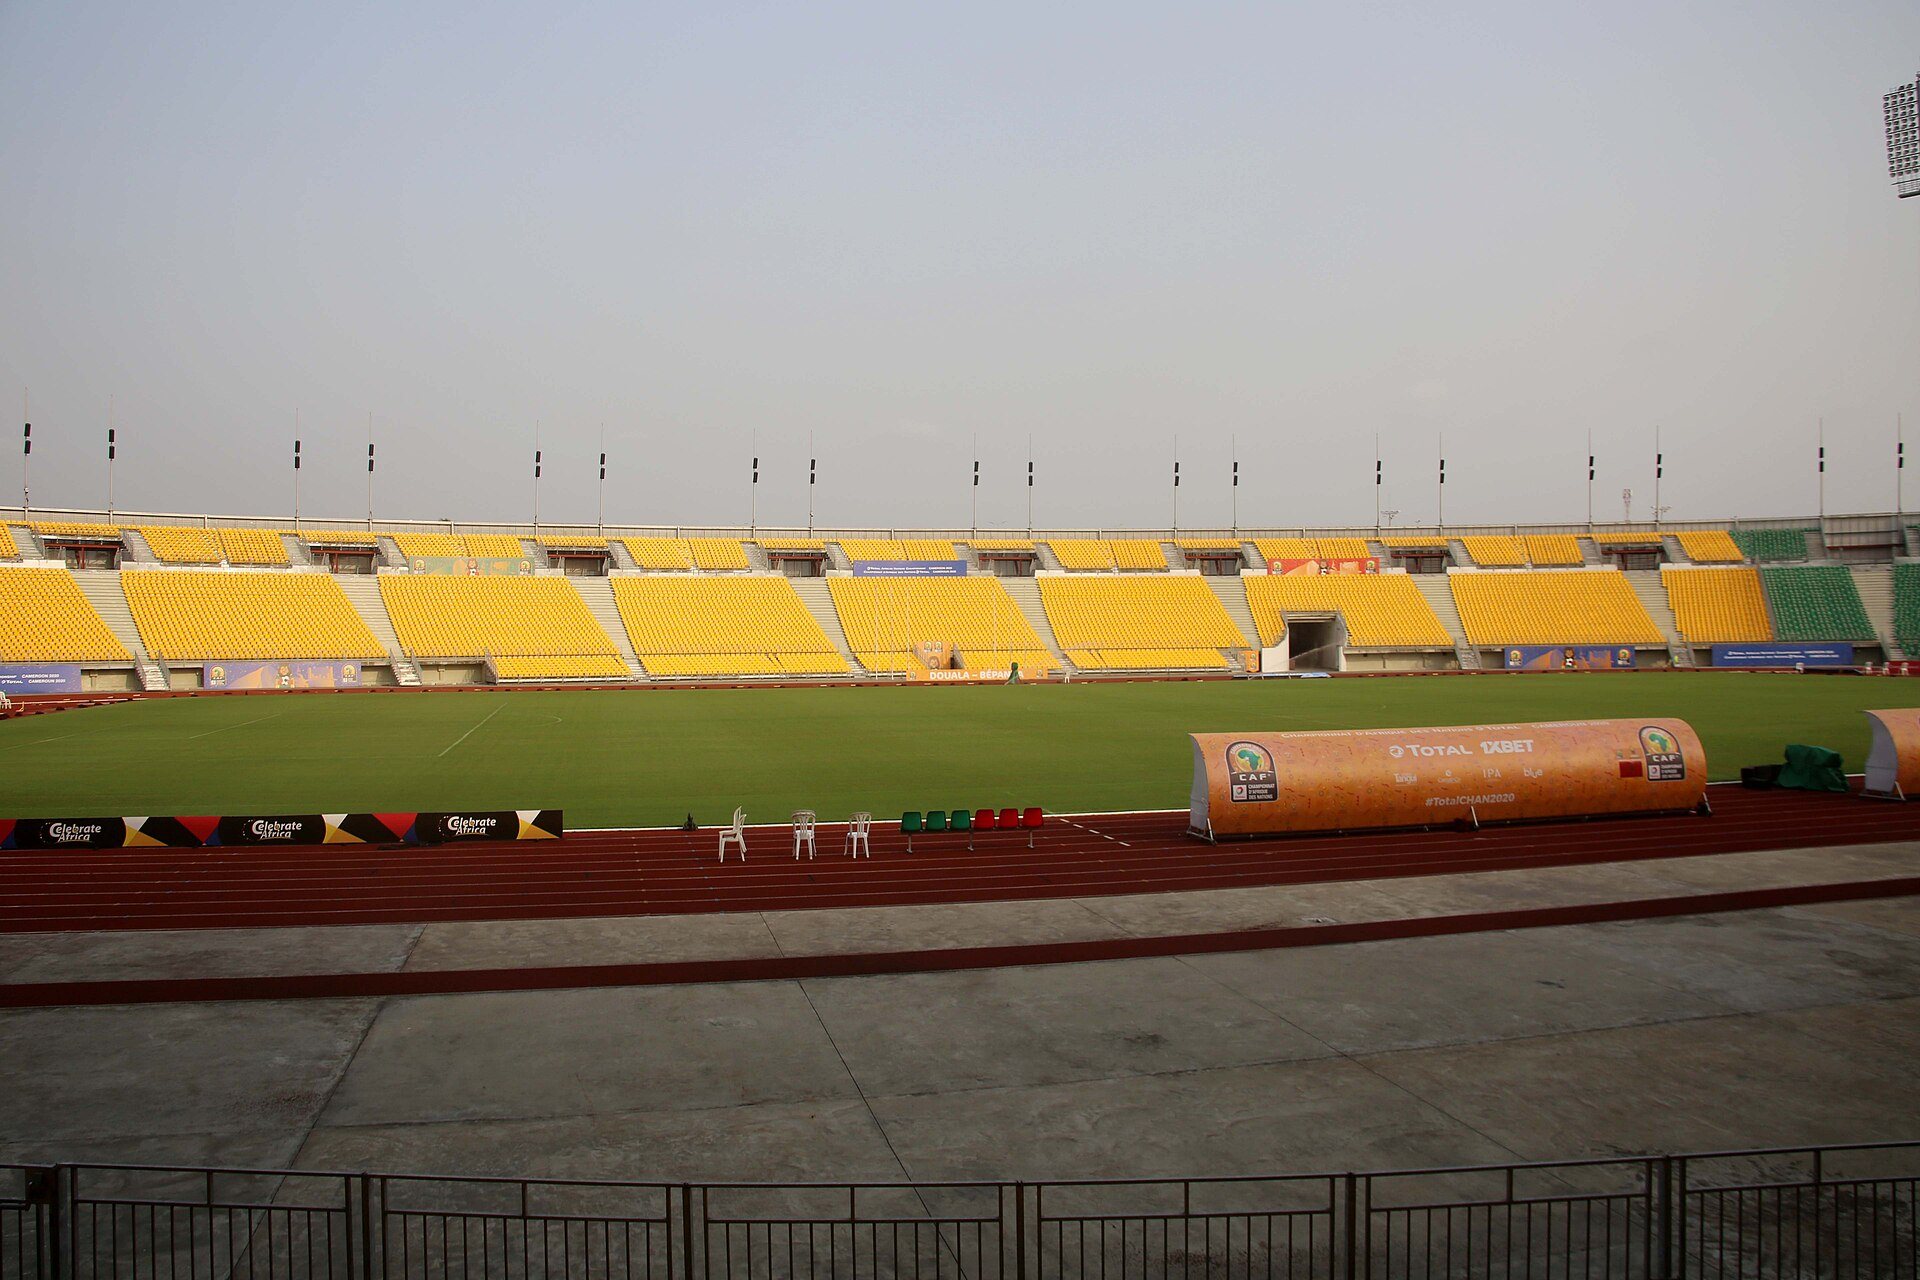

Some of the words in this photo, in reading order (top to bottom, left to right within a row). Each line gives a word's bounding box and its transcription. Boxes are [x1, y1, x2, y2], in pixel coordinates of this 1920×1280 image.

[929, 671, 970, 680] DOUALA
[979, 669, 1024, 680] BÉPANA
[1405, 744, 1473, 757] TOTAL
[1480, 739, 1534, 754] 1XBET
[1652, 754, 1676, 762] CAF
[1523, 767, 1544, 779] blue
[1425, 793, 1516, 807] #TotalCHAN2020
[251, 820, 303, 835] Celebrate
[447, 815, 497, 831] Celebrate
[49, 822, 102, 838] Celebrate
[260, 829, 292, 839] Africa
[455, 825, 486, 835] Africa
[57, 831, 91, 842] Africa
